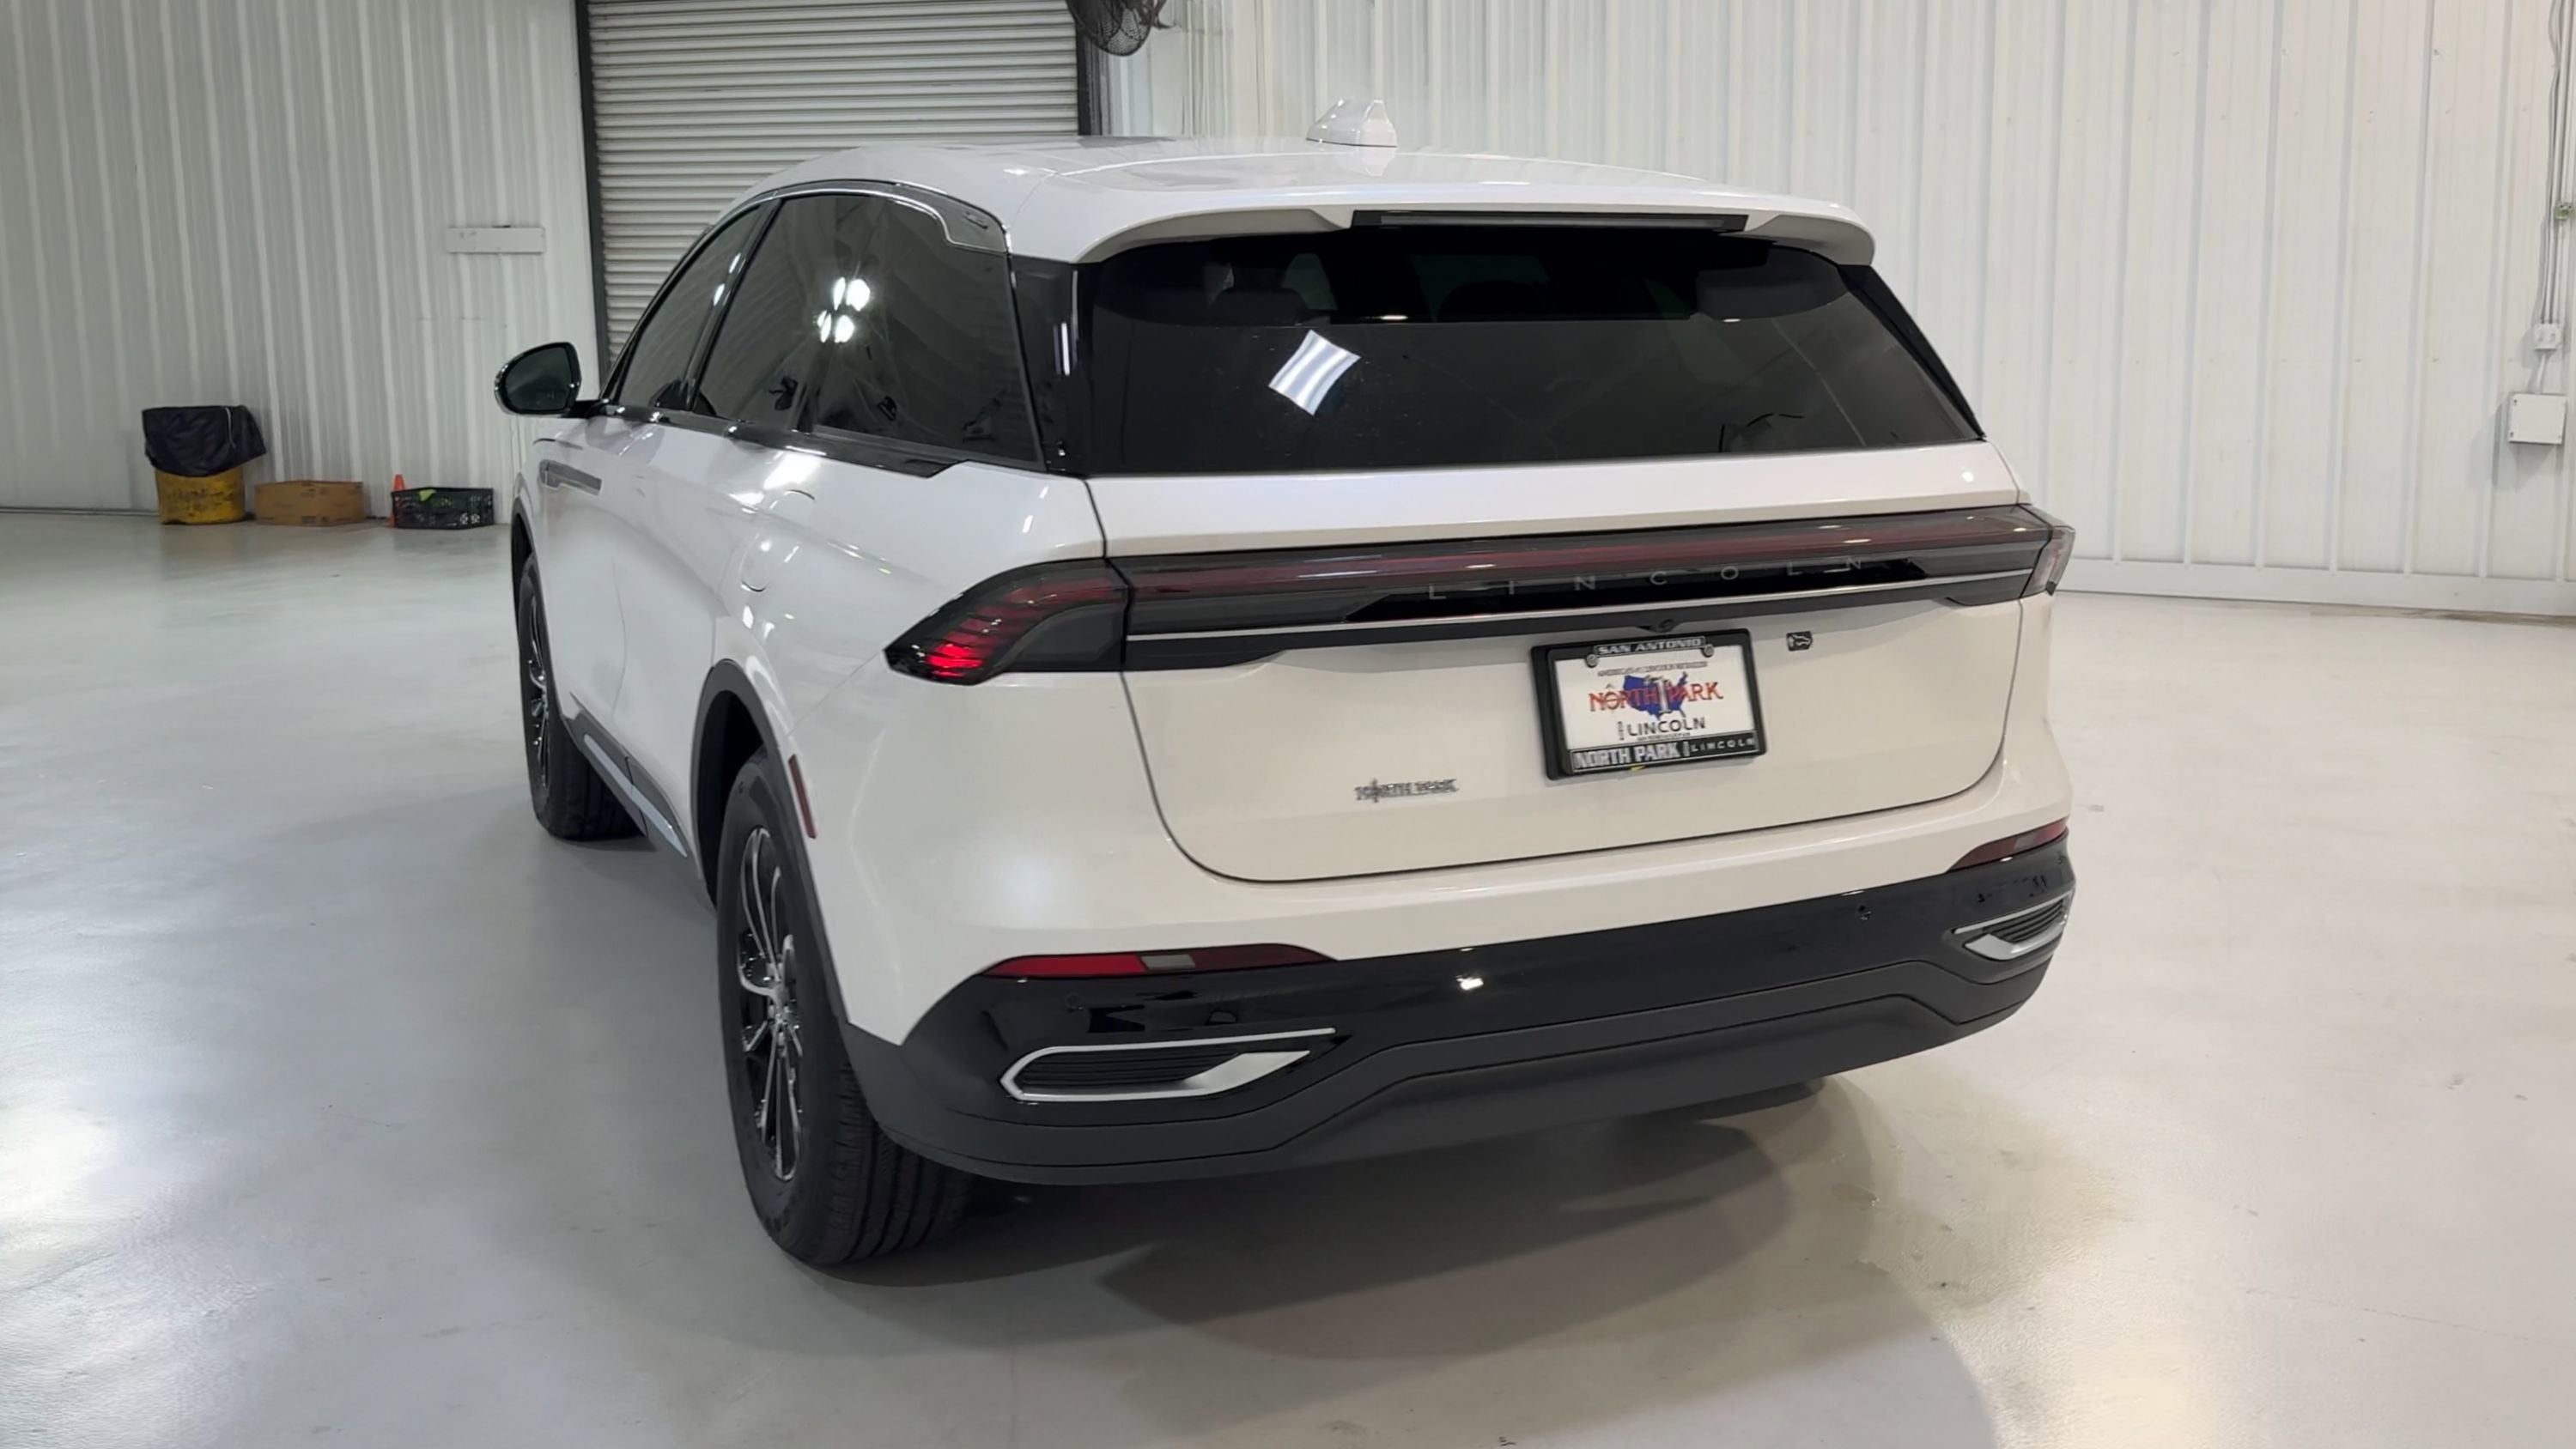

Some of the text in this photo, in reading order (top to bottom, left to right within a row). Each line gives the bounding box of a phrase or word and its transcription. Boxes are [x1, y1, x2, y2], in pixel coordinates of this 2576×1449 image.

[1429, 555, 1862, 600] LINCOLN
[1598, 638, 1702, 654] SAN ANTONIO
[1589, 682, 1724, 712] NORTH PARK
[1627, 717, 1706, 737] LINCOLN
[1573, 737, 1755, 768] NORTH PARK LINCOLN
